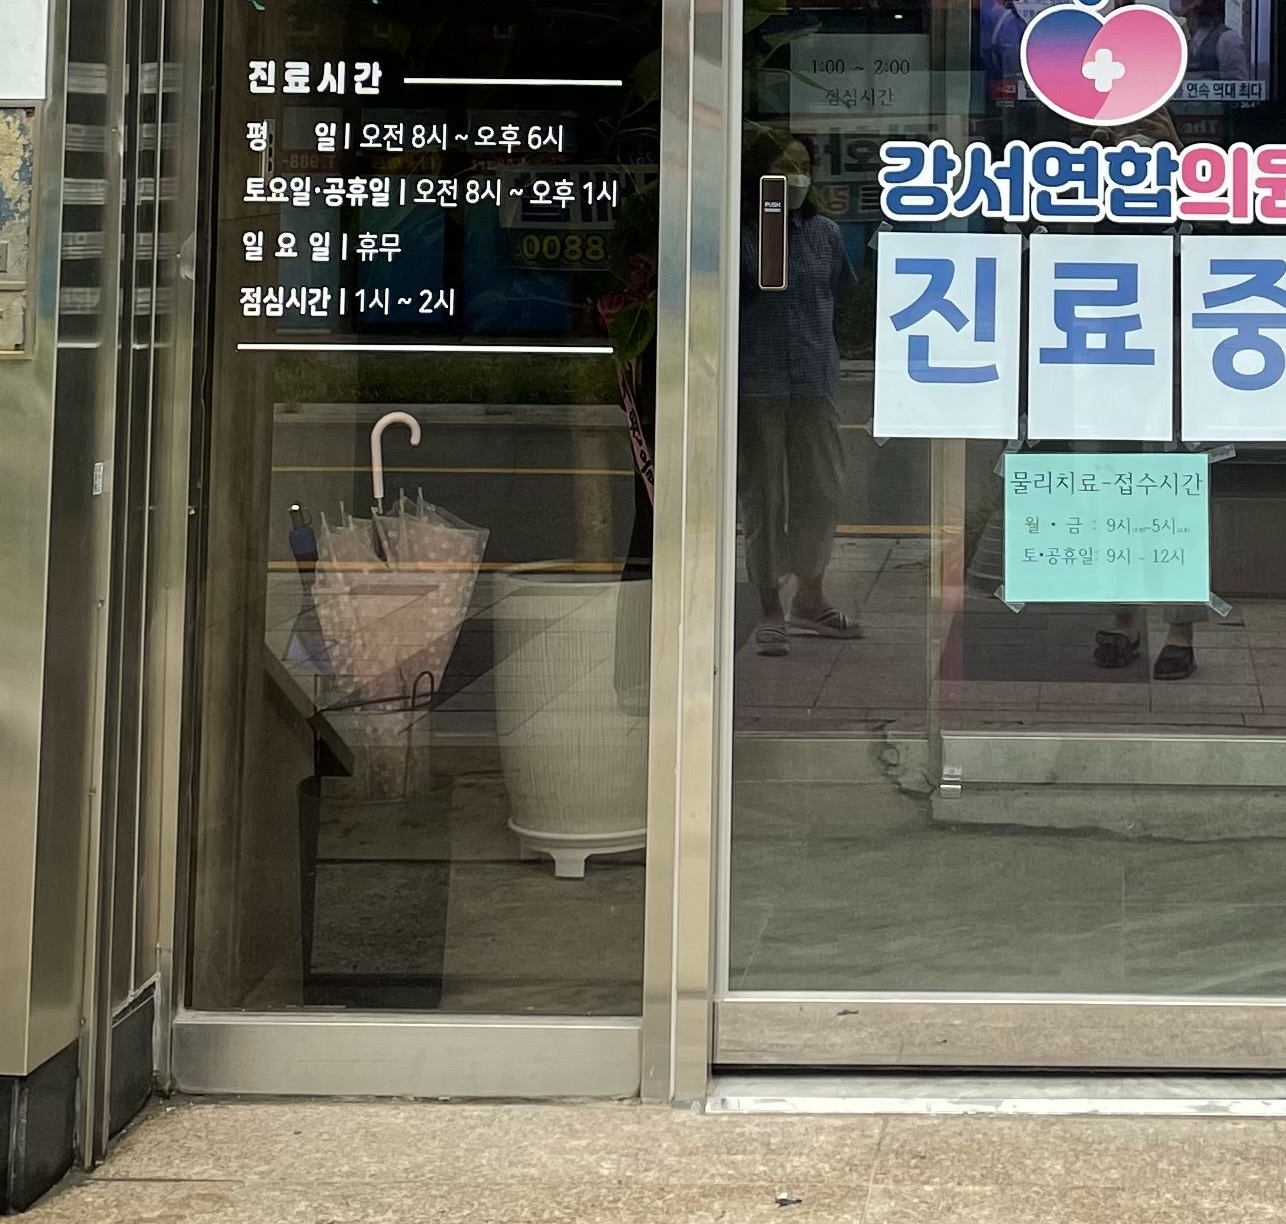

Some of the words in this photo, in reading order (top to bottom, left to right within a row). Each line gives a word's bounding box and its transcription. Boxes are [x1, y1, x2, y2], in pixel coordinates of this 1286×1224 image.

[248, 60, 383, 95] 진료시간
[811, 59, 845, 75] 1:00
[873, 59, 910, 75] 2:00
[1186, 82, 1209, 100] 연속
[1212, 82, 1237, 99] 역대
[1238, 82, 1263, 99] 최다
[360, 123, 404, 153] 오전
[411, 123, 448, 151] 8시
[474, 124, 521, 153] 오후
[527, 124, 564, 153] 6시
[413, 178, 459, 207] 오전
[465, 179, 502, 206] 8시
[529, 179, 576, 209] 오후
[582, 180, 618, 207] 1시
[356, 232, 402, 262] 휴무
[239, 286, 331, 317] 점심시간
[355, 288, 390, 316] 1시
[419, 288, 456, 316] 2시
[1106, 548, 1131, 565] 9시
[1152, 548, 1184, 565] 12시
